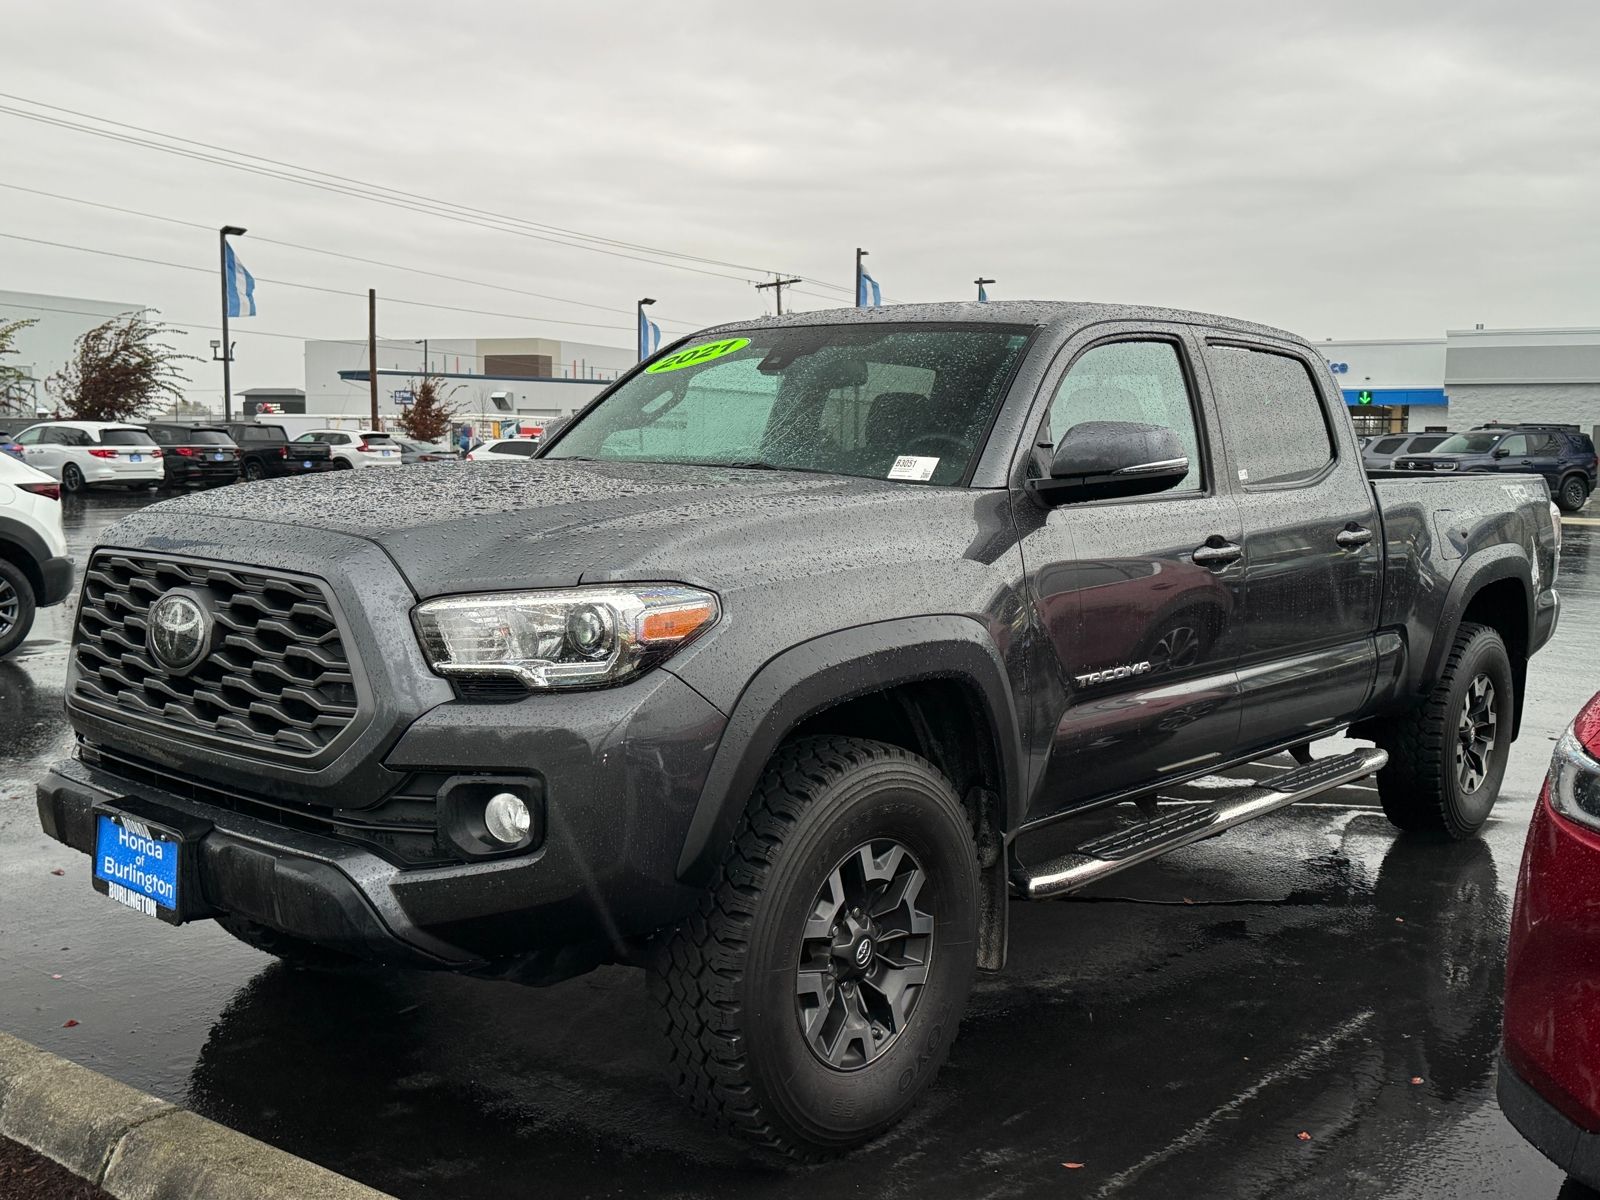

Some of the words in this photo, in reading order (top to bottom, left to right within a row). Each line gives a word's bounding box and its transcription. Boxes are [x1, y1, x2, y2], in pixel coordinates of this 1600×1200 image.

[652, 340, 738, 372] 2021
[1074, 661, 1151, 688] TACOMA
[119, 828, 163, 860] Honda
[135, 855, 145, 867] of
[104, 856, 173, 899] Burlington
[108, 881, 157, 918] BURLINGTON
